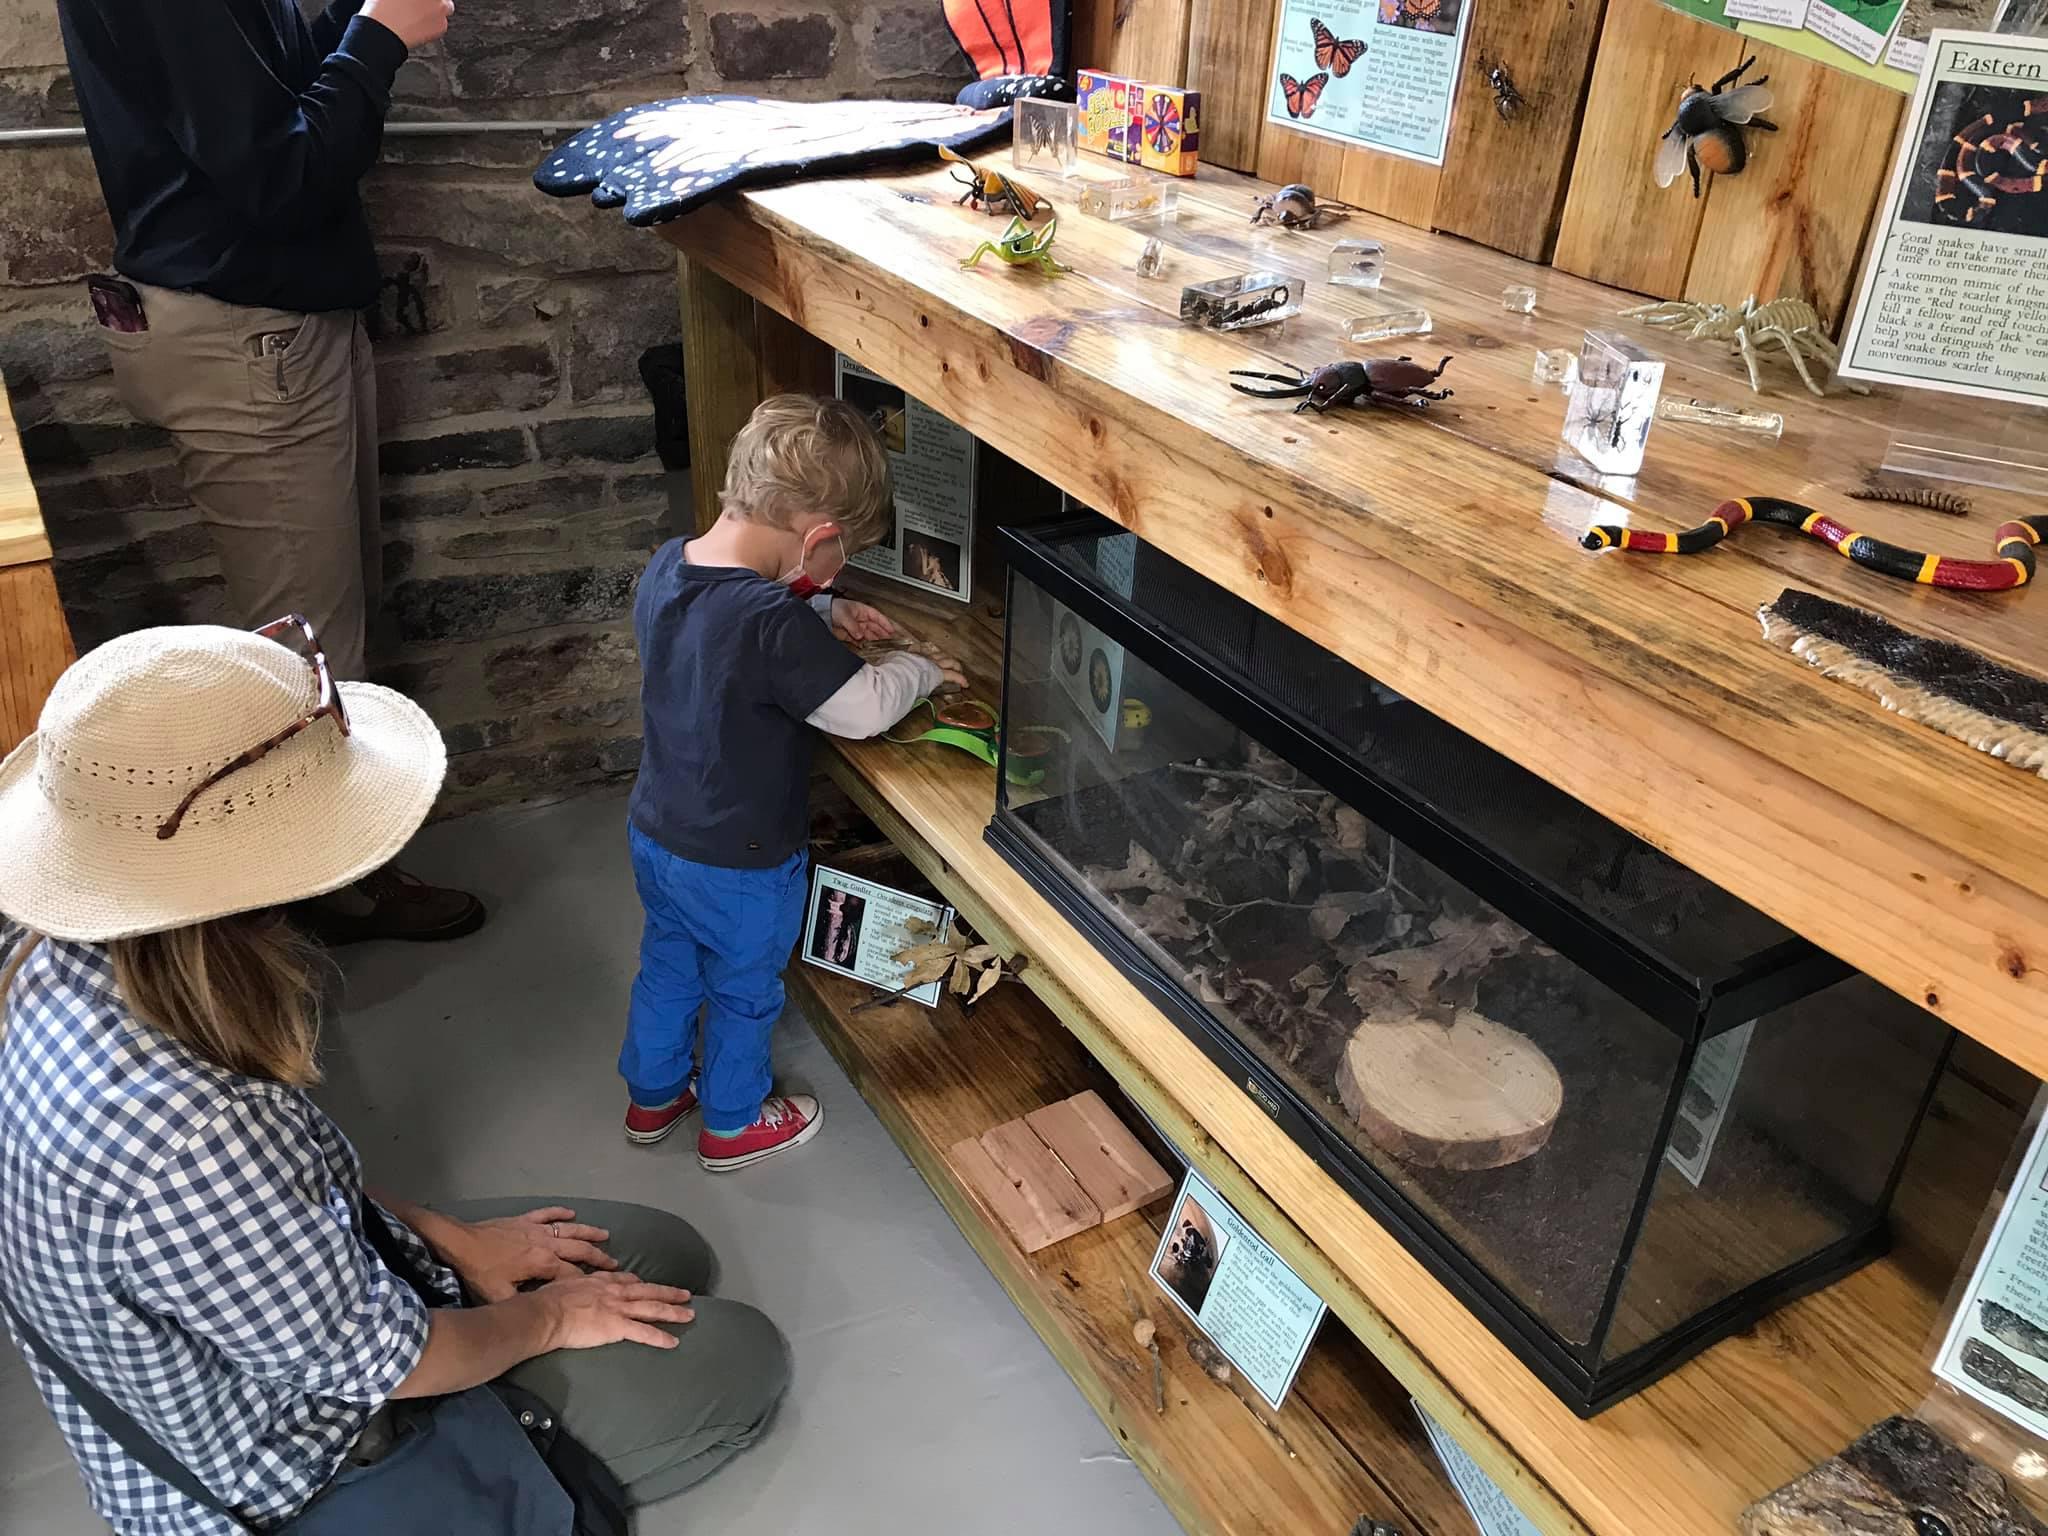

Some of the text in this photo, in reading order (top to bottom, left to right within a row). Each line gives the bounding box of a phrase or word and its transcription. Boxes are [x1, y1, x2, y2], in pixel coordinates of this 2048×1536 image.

[1949, 50, 2041, 79] Eastern
[1899, 241, 1929, 256] fangs
[1936, 246, 1958, 258] that
[1964, 251, 1989, 262] take
[1995, 256, 2026, 267] more
[1902, 232, 2047, 259] Coral snakes have small
[1896, 253, 1922, 264] time
[1928, 257, 1941, 266] to
[1946, 261, 2018, 276] envenomate
[1888, 281, 1919, 293] snake
[1925, 286, 1934, 294] is
[1939, 286, 1958, 297] the
[1962, 291, 2000, 303] scarlet
[1890, 268, 2045, 297] A common mimic of the
[1881, 301, 1901, 314] kill
[1905, 307, 1912, 315] a
[1918, 306, 1955, 320] fellow
[1960, 314, 1983, 325] and
[1987, 318, 2008, 328] red
[1884, 291, 1920, 304] rhyme
[1959, 302, 2011, 319] touching
[1878, 312, 1907, 326] black
[1914, 320, 1922, 328] is
[1927, 322, 1934, 330] a
[1940, 321, 1976, 335] friend
[1980, 328, 1996, 338] of
[1871, 338, 1995, 362] coral snake from the
[1874, 324, 1899, 339] help
[1903, 331, 1926, 342] you
[1931, 332, 1994, 350] distinguish
[2000, 342, 2019, 354] the
[1867, 349, 1947, 367] nonvenomous
[1952, 361, 1989, 373] scarlet
[1226, 1217, 1259, 1251] Goldenrod
[1259, 1250, 1275, 1266] Gall
[2006, 1284, 2032, 1302] their
[2010, 1273, 2041, 1296] From
